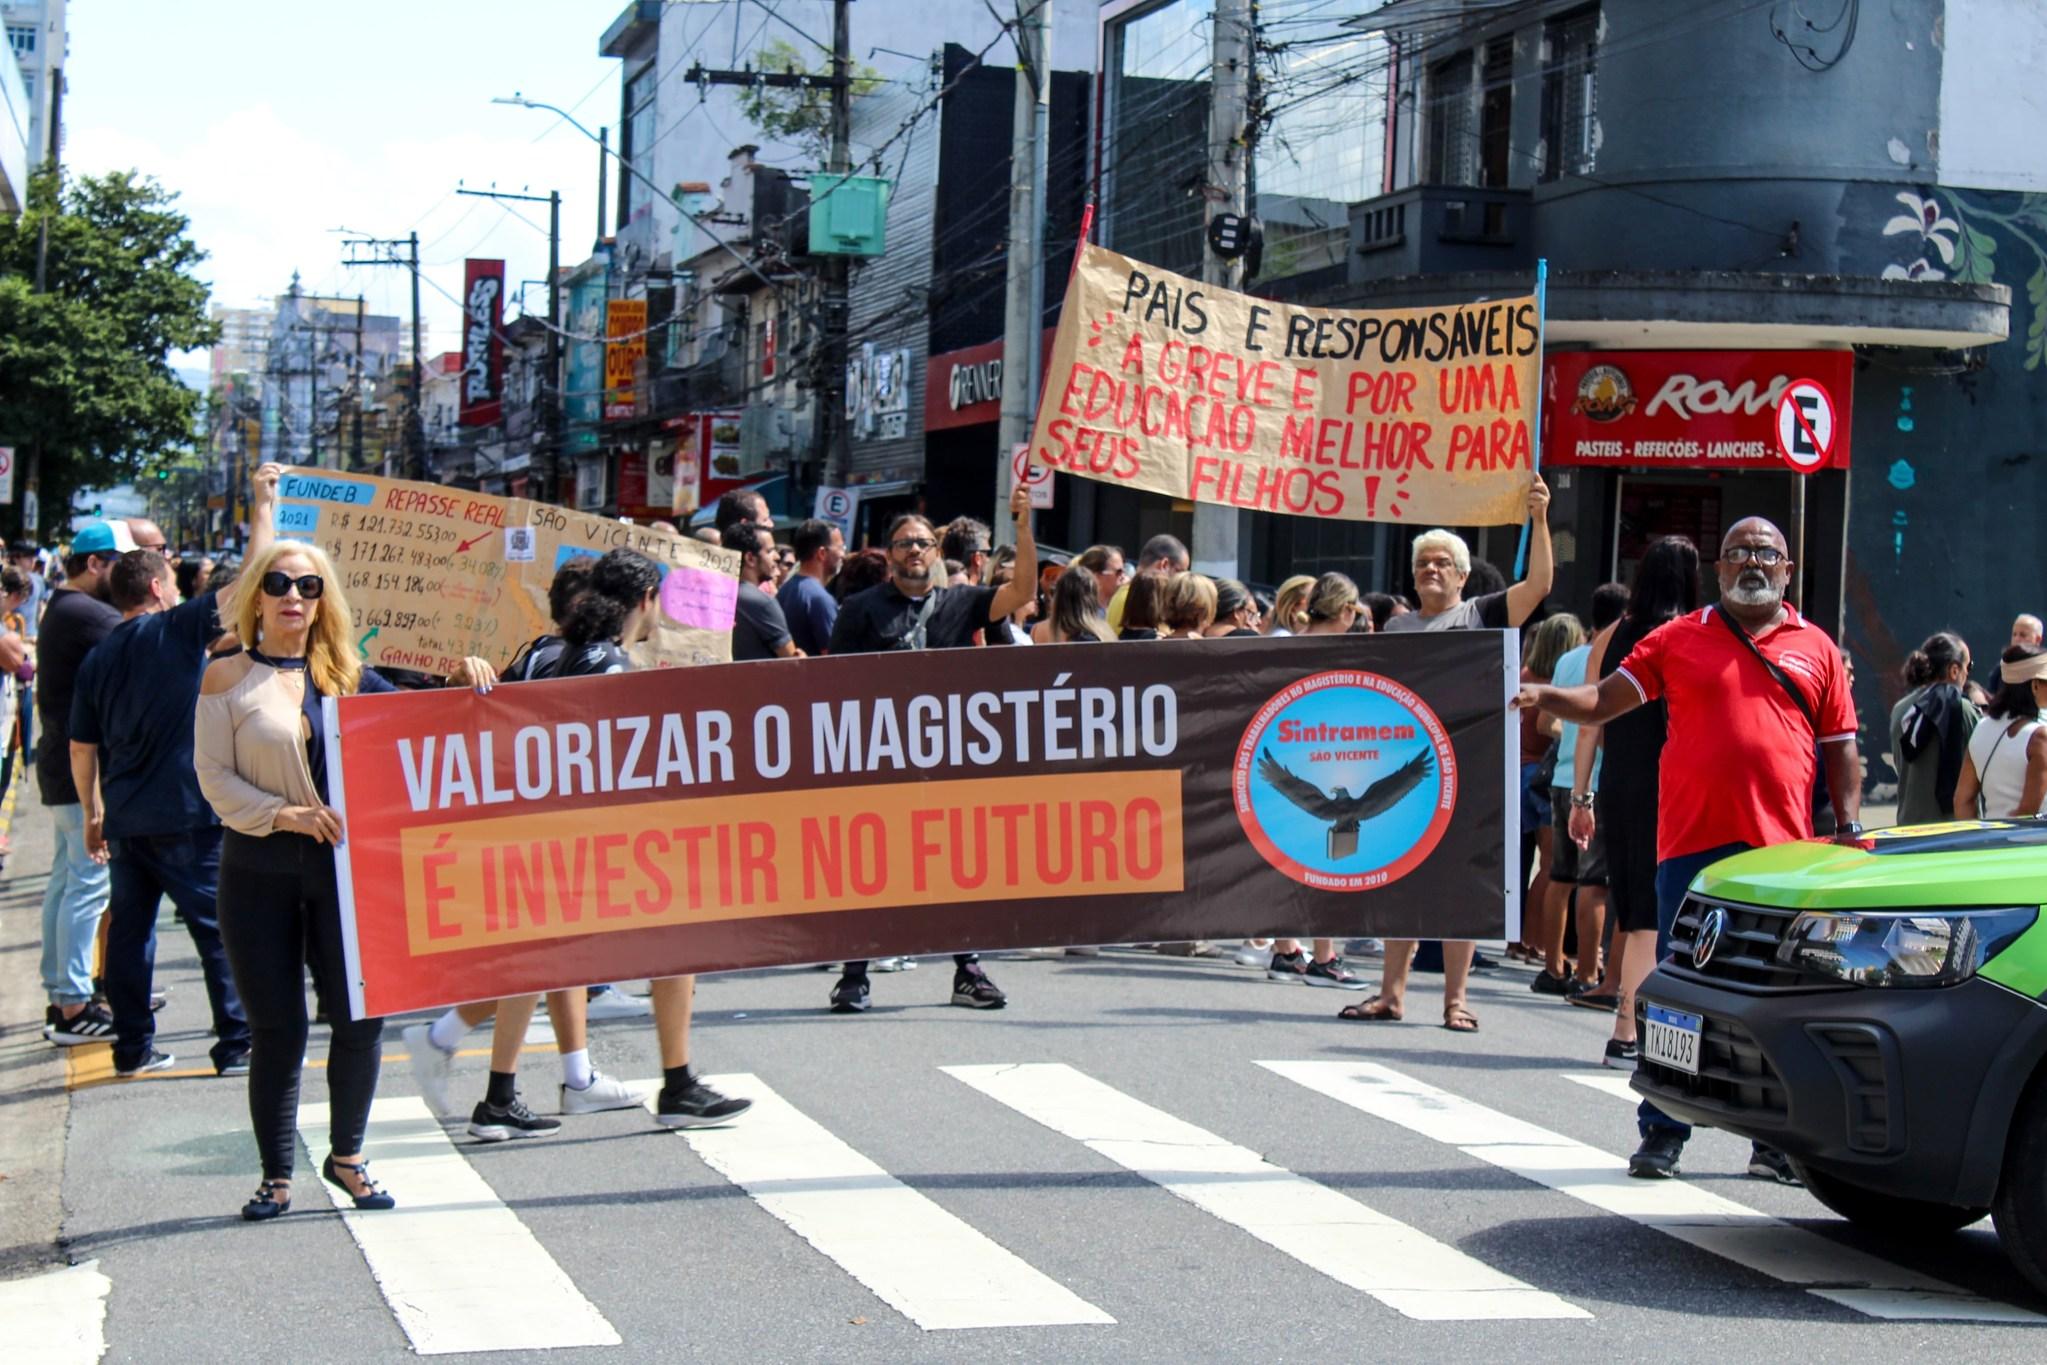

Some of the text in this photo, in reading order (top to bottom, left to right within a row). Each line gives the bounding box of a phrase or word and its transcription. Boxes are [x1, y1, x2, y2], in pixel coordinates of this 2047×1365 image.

[1123, 270, 1539, 363] PAIS E RESPONSÁVEIS
[1121, 332, 1143, 374] A
[1158, 340, 1281, 406] GREVE
[1346, 370, 1417, 415] POR
[1439, 363, 1520, 414] UMA
[1280, 415, 1434, 471] MELHOR
[1446, 419, 1532, 472] PARA
[1575, 441, 1623, 457] PASTEIS
[1706, 441, 1765, 458] LANCHES
[1040, 419, 1140, 479] SEUS
[1190, 456, 1344, 516] FILHOS
[285, 479, 358, 503] FUNDEB
[280, 510, 309, 526] 2021
[385, 488, 505, 528] REPASSE REAL
[532, 507, 567, 532] SÃO
[380, 646, 434, 668] GANHO
[1289, 684, 1303, 698] NO
[1303, 672, 1354, 692] MAGISTÉRIO
[1355, 675, 1361, 684] E
[1363, 675, 1375, 688] NA
[397, 672, 1178, 812] VALORIZAR O MAGISTÉRIO
[1277, 719, 1415, 742] Sintramem
[1310, 749, 1379, 762] SÃO VICENTE
[422, 796, 1164, 941] É INVESTIR NO FUTURO
[1304, 871, 1388, 887] FUNDADO EM 2010
